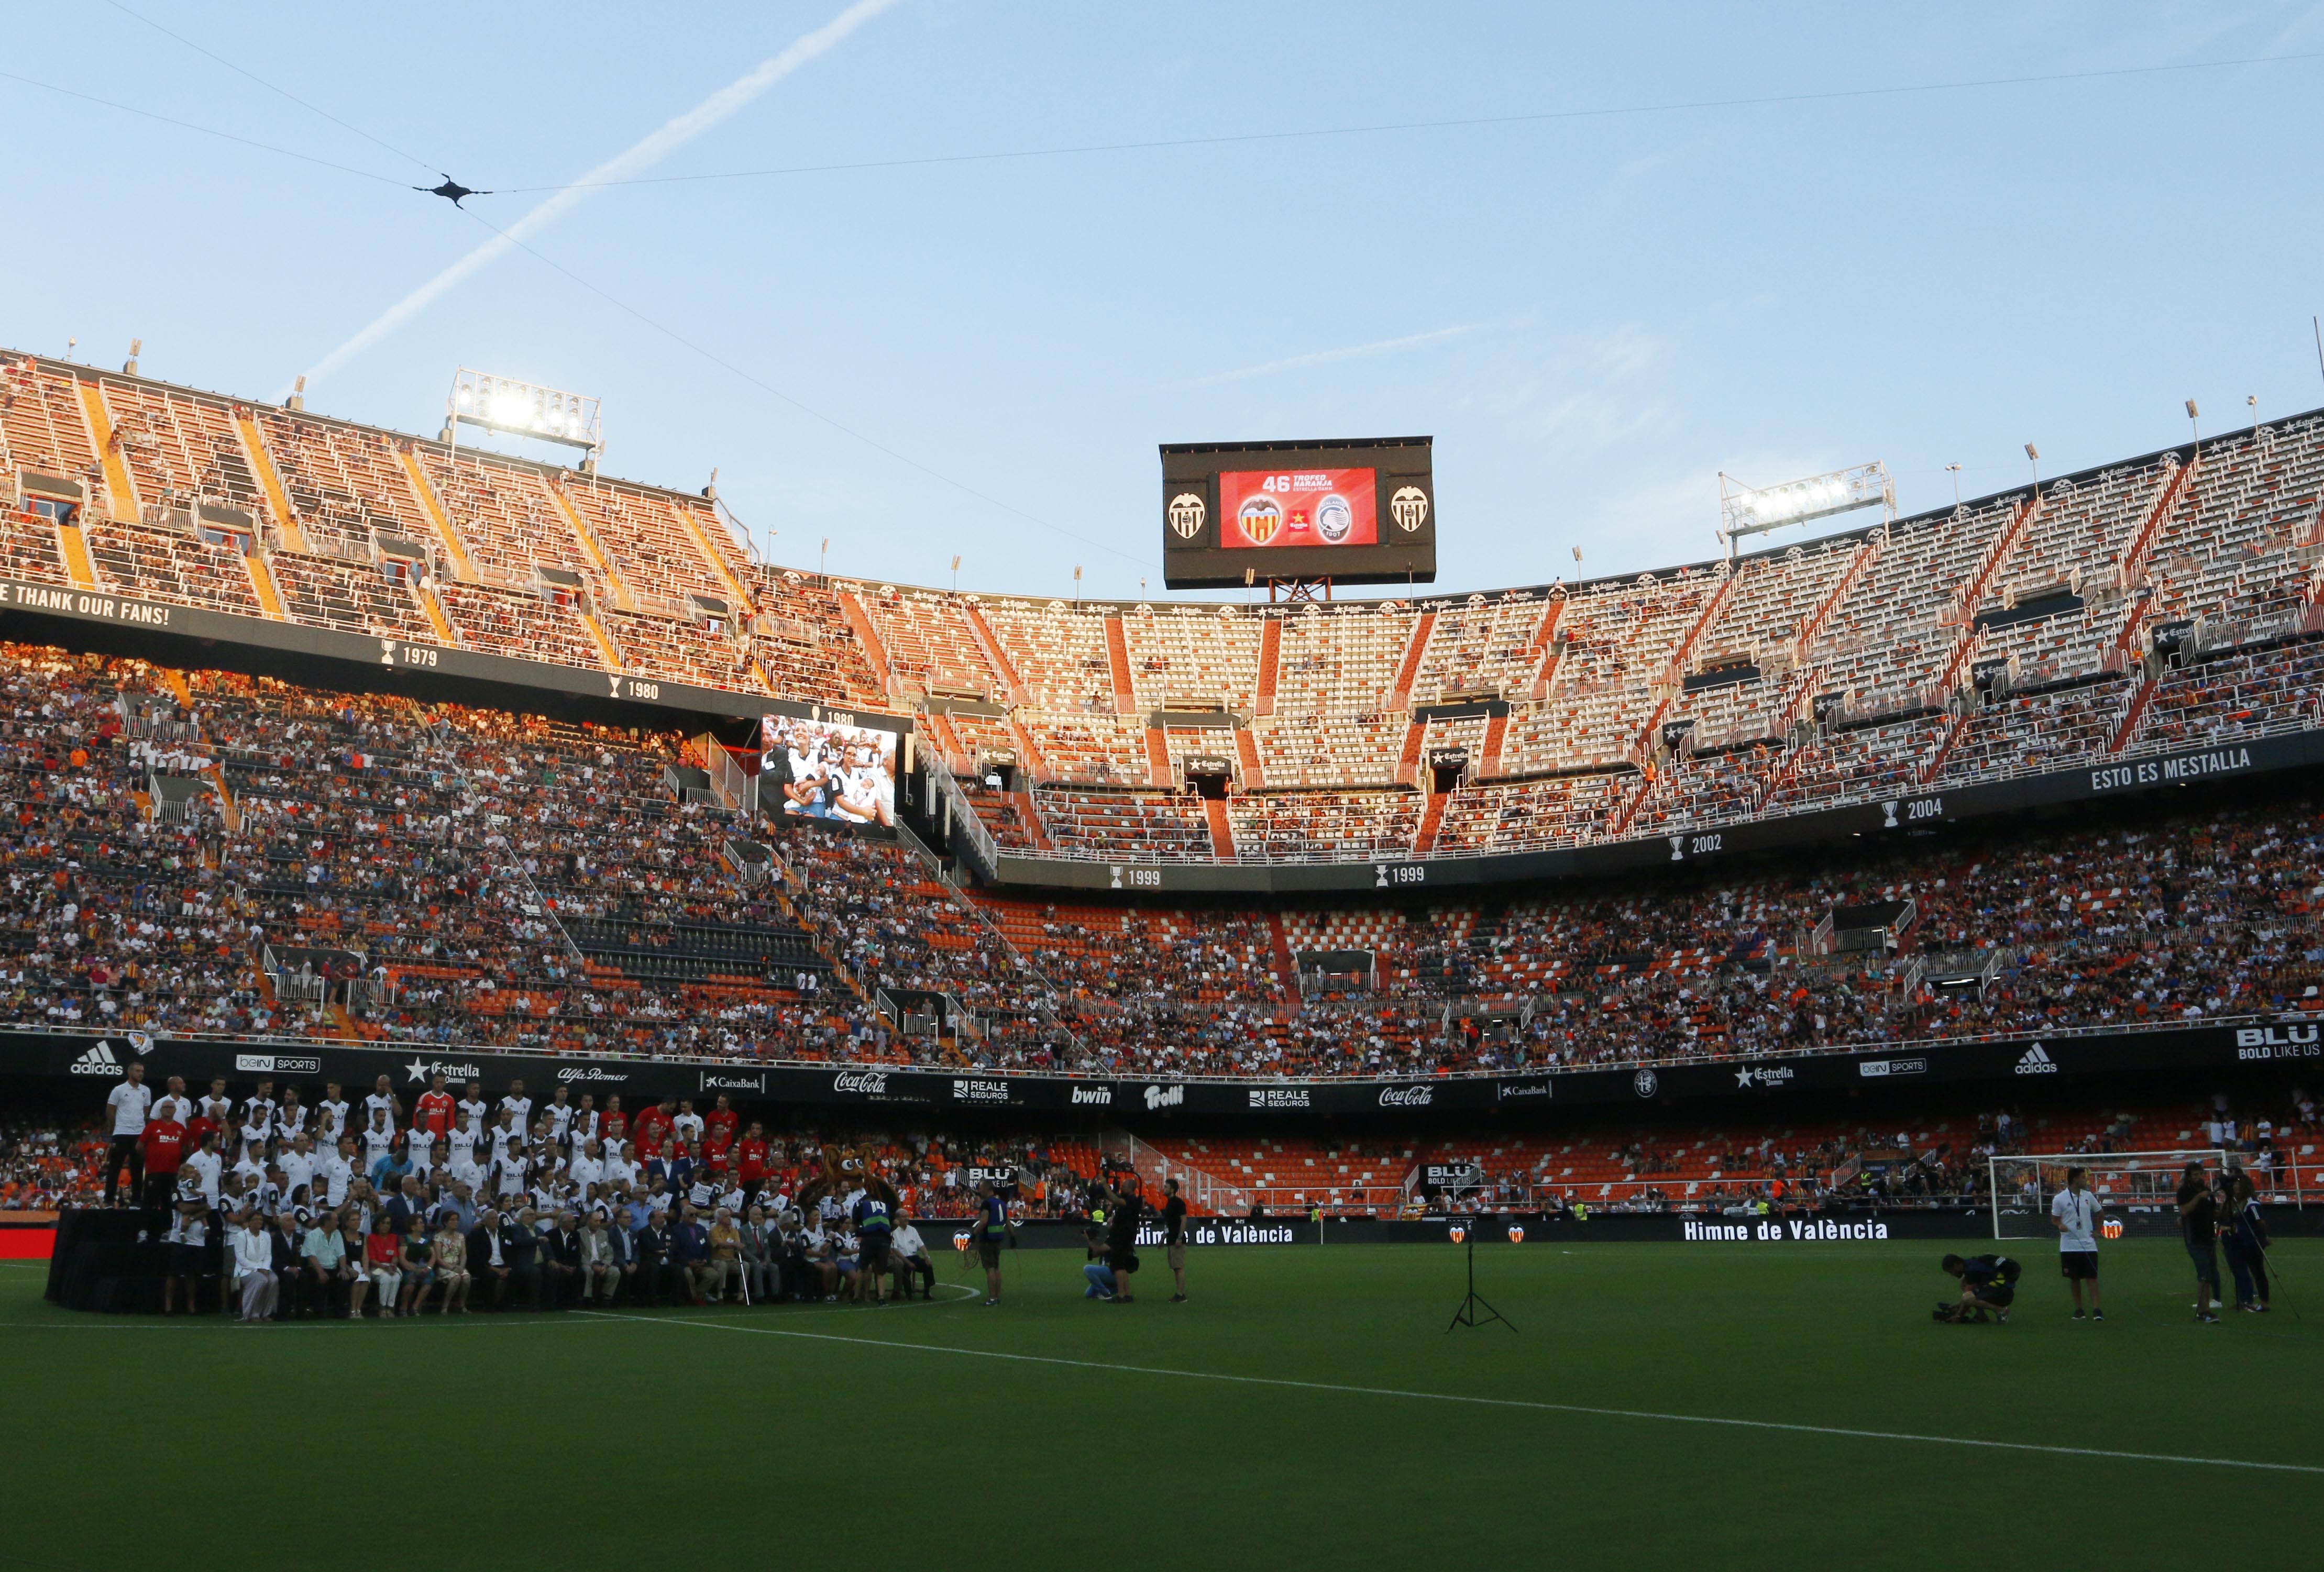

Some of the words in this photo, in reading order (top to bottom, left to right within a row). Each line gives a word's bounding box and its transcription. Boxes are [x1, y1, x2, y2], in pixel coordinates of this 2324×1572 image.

[1262, 475, 1290, 493] 46
[16, 586, 73, 611] THANK
[80, 596, 114, 617] OUR
[120, 601, 170, 626] FANS!
[403, 647, 437, 667] 1979
[629, 681, 659, 700] 1980
[827, 711, 854, 726] 1980
[992, 751, 1015, 759] Estrella
[2091, 766, 2132, 790] ESTO
[2138, 762, 2158, 784] ES
[2164, 748, 2251, 779] MESTALLA
[1908, 798, 1942, 820] 2004
[1692, 834, 1722, 854] 2002
[1129, 870, 1160, 886] 1999
[1392, 867, 1425, 883] 1999
[2238, 1047, 2271, 1060] BOLD
[2274, 1045, 2301, 1058] LIKE
[2304, 1044, 2321, 1056] US
[70, 1062, 124, 1076] adidas
[277, 1059, 316, 1070] SPORTS
[431, 1061, 480, 1078] Estrella
[1891, 1061, 1924, 1072] SPORTS
[2015, 1062, 2058, 1075] adidas
[557, 1068, 587, 1083] Alfa
[586, 1068, 629, 1081] Romeo
[834, 1071, 888, 1093] Coca-Cola
[1755, 1067, 1794, 1081] Estrella
[718, 1078, 759, 1089] CaixaBank
[971, 1081, 1007, 1091] REALE
[1513, 1085, 1547, 1095] CaixaBank
[971, 1091, 1008, 1100] SEGUROS
[1072, 1086, 1111, 1104] bwin
[1144, 1084, 1184, 1110] Trolli
[1268, 1091, 1309, 1100] REALE
[1379, 1086, 1434, 1107] Coca-Cola
[870, 1201, 886, 1213] 14
[1195, 1226, 1215, 1244] de
[1221, 1225, 1293, 1243] València
[1684, 1221, 1748, 1241] Himne
[1757, 1221, 1782, 1241] de
[1789, 1219, 1888, 1240] València
